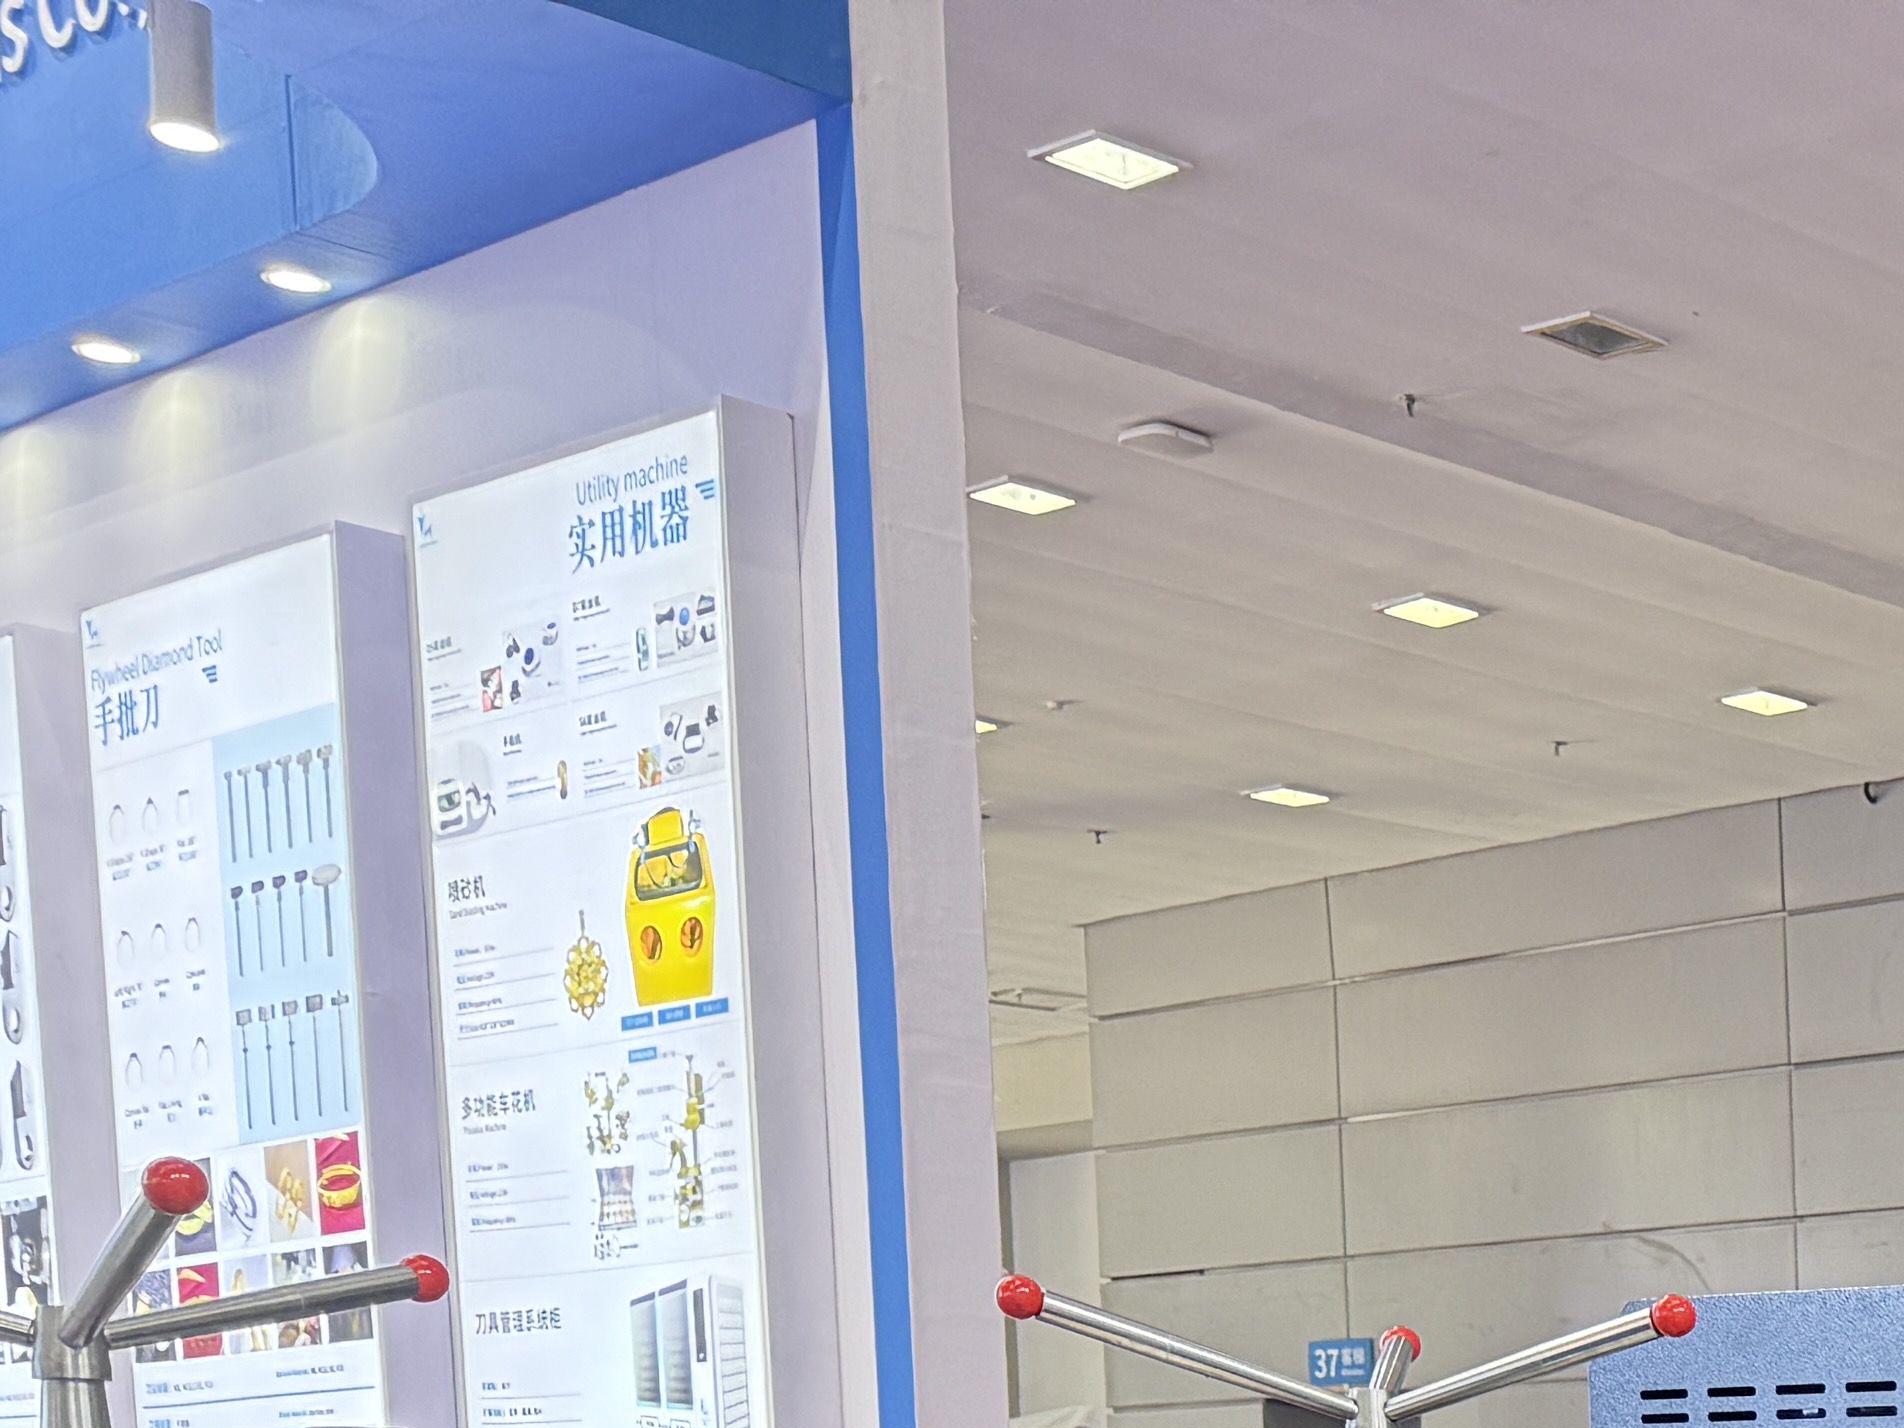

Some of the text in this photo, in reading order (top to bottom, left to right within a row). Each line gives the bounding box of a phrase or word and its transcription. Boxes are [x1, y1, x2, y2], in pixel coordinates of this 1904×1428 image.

[576, 454, 688, 506] Utility machine
[569, 485, 689, 575] 实用机器
[196, 628, 223, 659] Tool
[94, 684, 159, 746] 手批刀
[1314, 1349, 1339, 1378] 37
